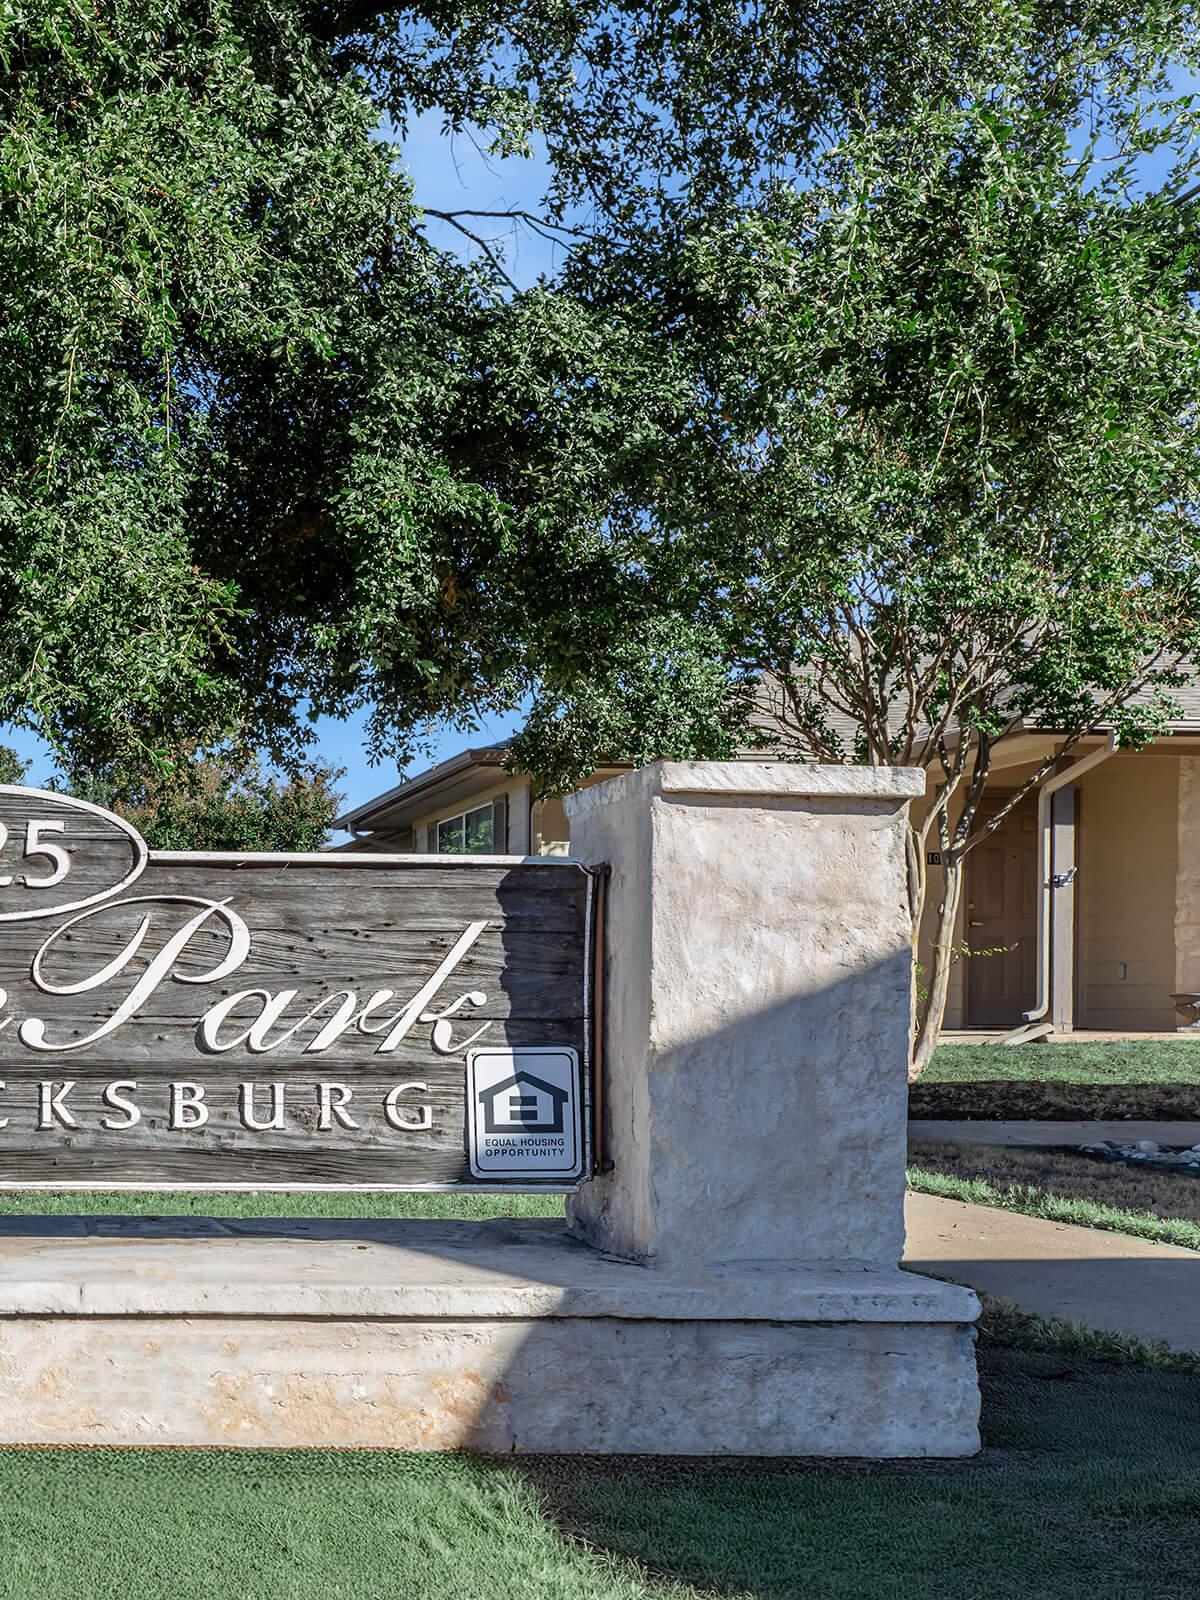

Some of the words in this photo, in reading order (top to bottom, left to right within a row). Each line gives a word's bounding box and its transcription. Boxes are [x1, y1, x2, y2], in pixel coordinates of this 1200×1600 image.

[19, 895, 492, 1055] Park
[485, 1138, 518, 1147] EQUAL
[520, 1138, 565, 1147] HOUSING
[485, 1148, 565, 1157] OPPORTUNITY
